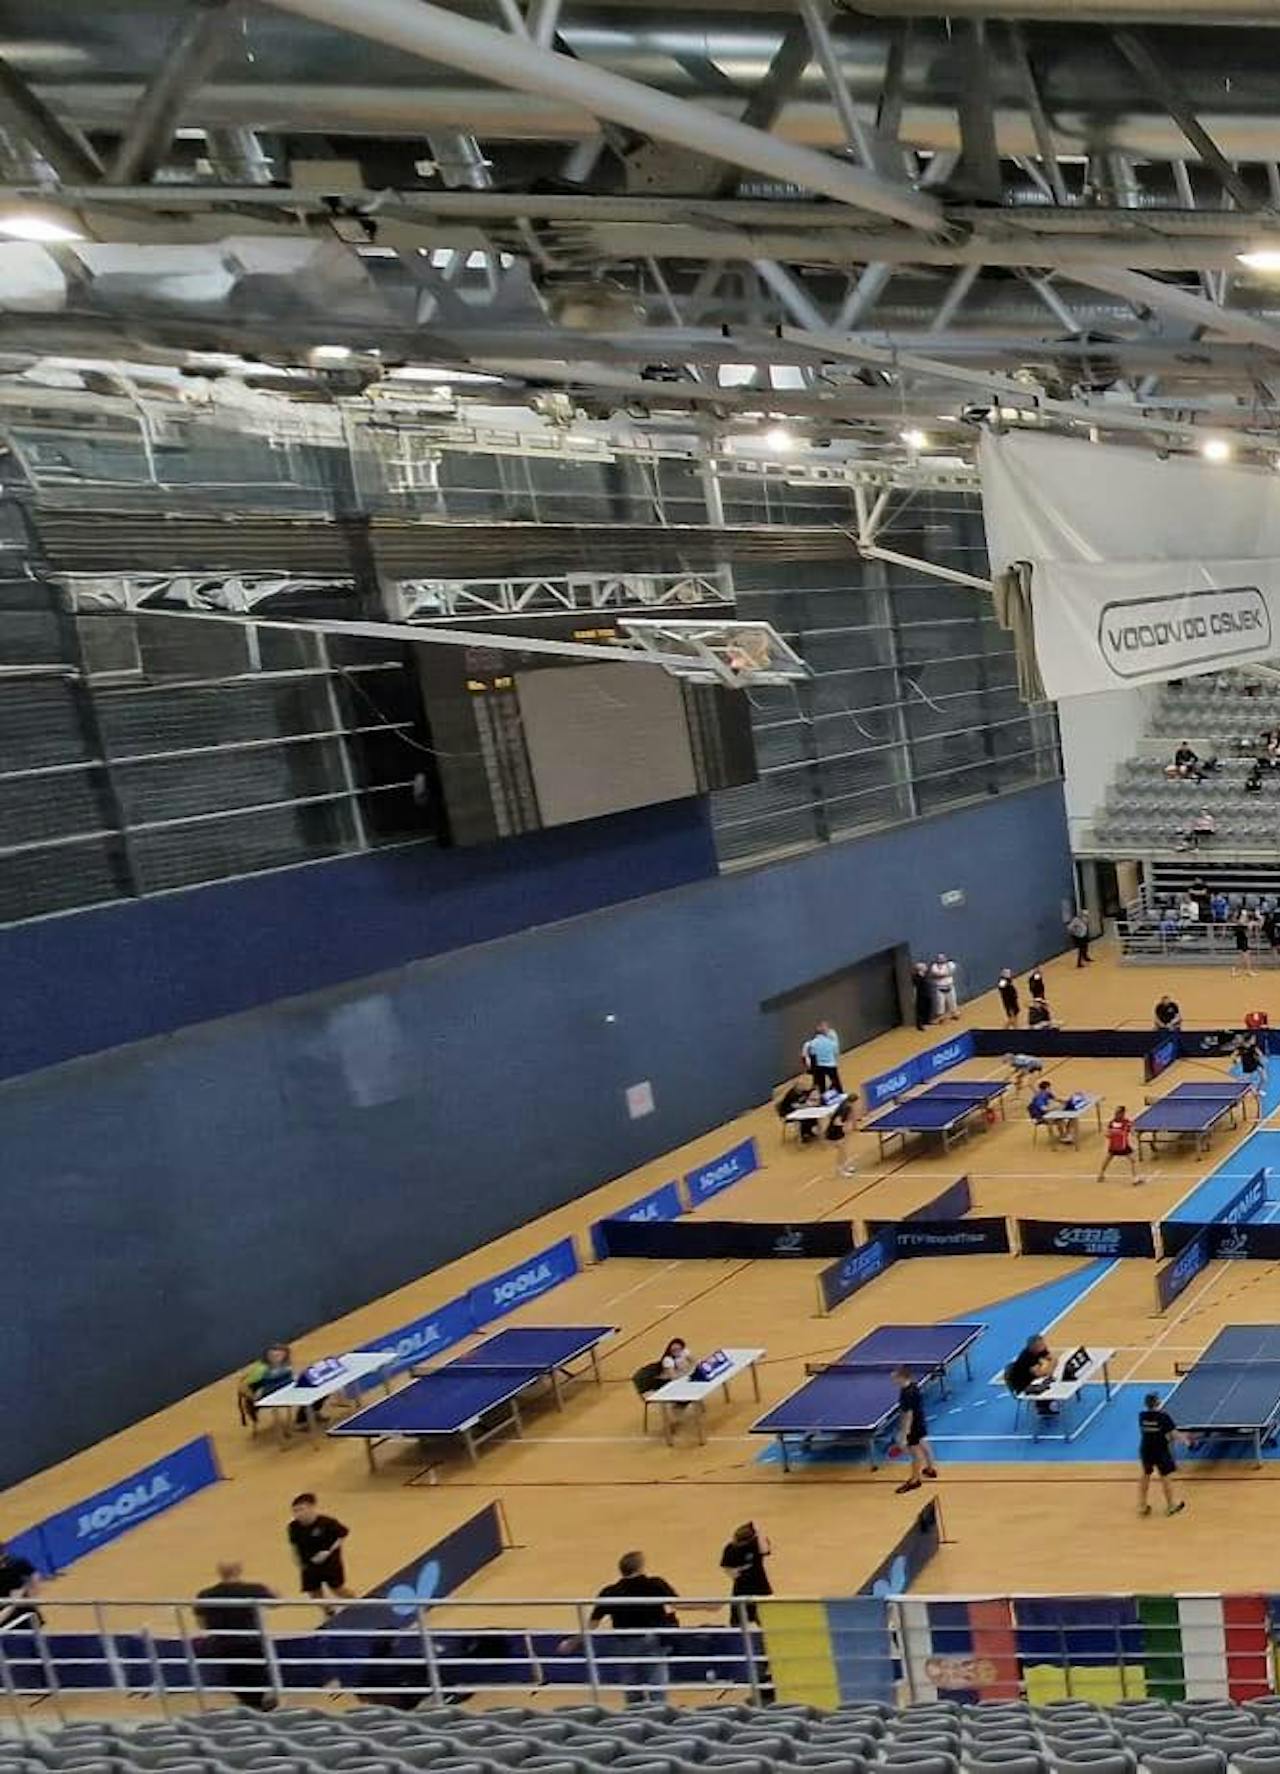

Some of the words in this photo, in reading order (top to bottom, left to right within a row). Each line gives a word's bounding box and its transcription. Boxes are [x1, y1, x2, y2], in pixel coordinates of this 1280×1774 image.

[1108, 617, 1207, 652] VODOVOD
[491, 1264, 552, 1305] JOOLA
[77, 1474, 173, 1539] JOOLA
